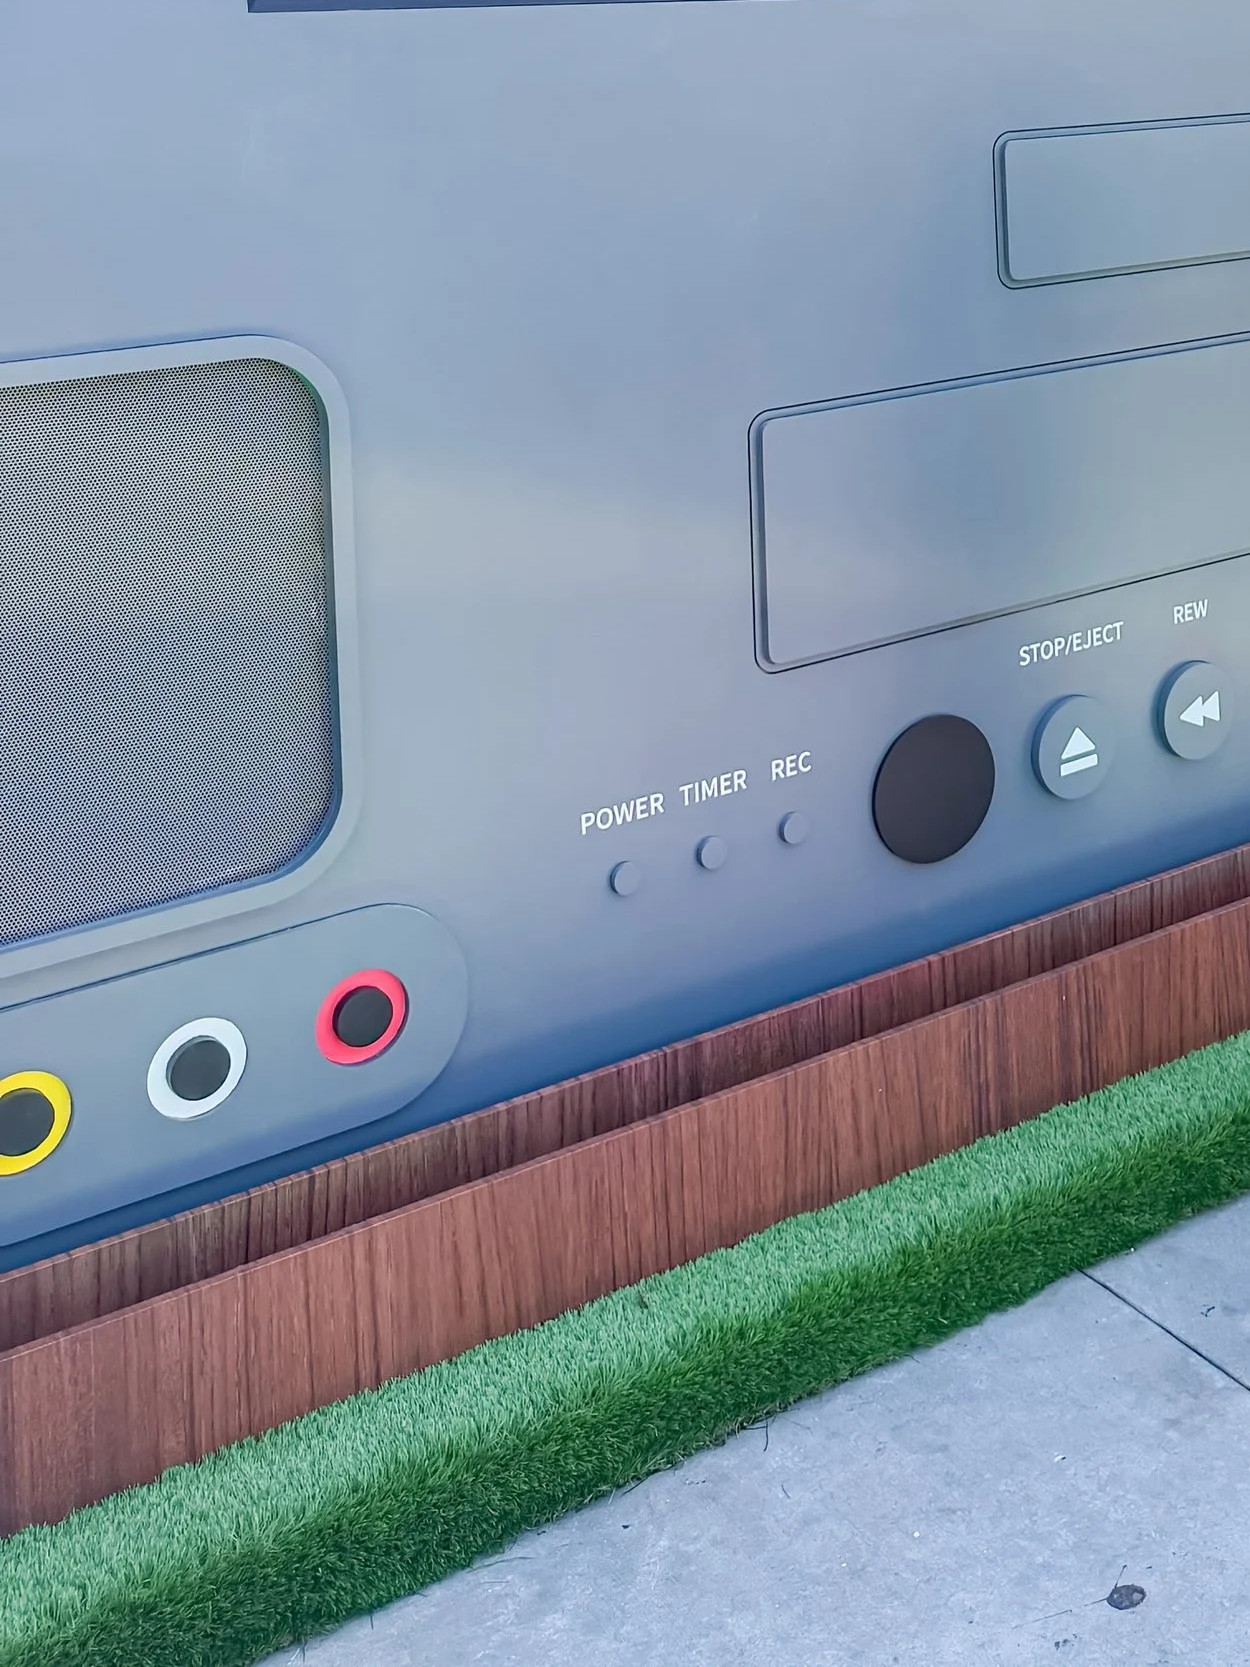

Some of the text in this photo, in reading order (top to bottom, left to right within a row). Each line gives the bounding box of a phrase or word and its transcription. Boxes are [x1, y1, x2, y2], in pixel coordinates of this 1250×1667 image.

[1173, 599, 1209, 625] REW
[1018, 621, 1125, 667] STOP/EJECT
[580, 750, 812, 836] POWER TIMER REC
